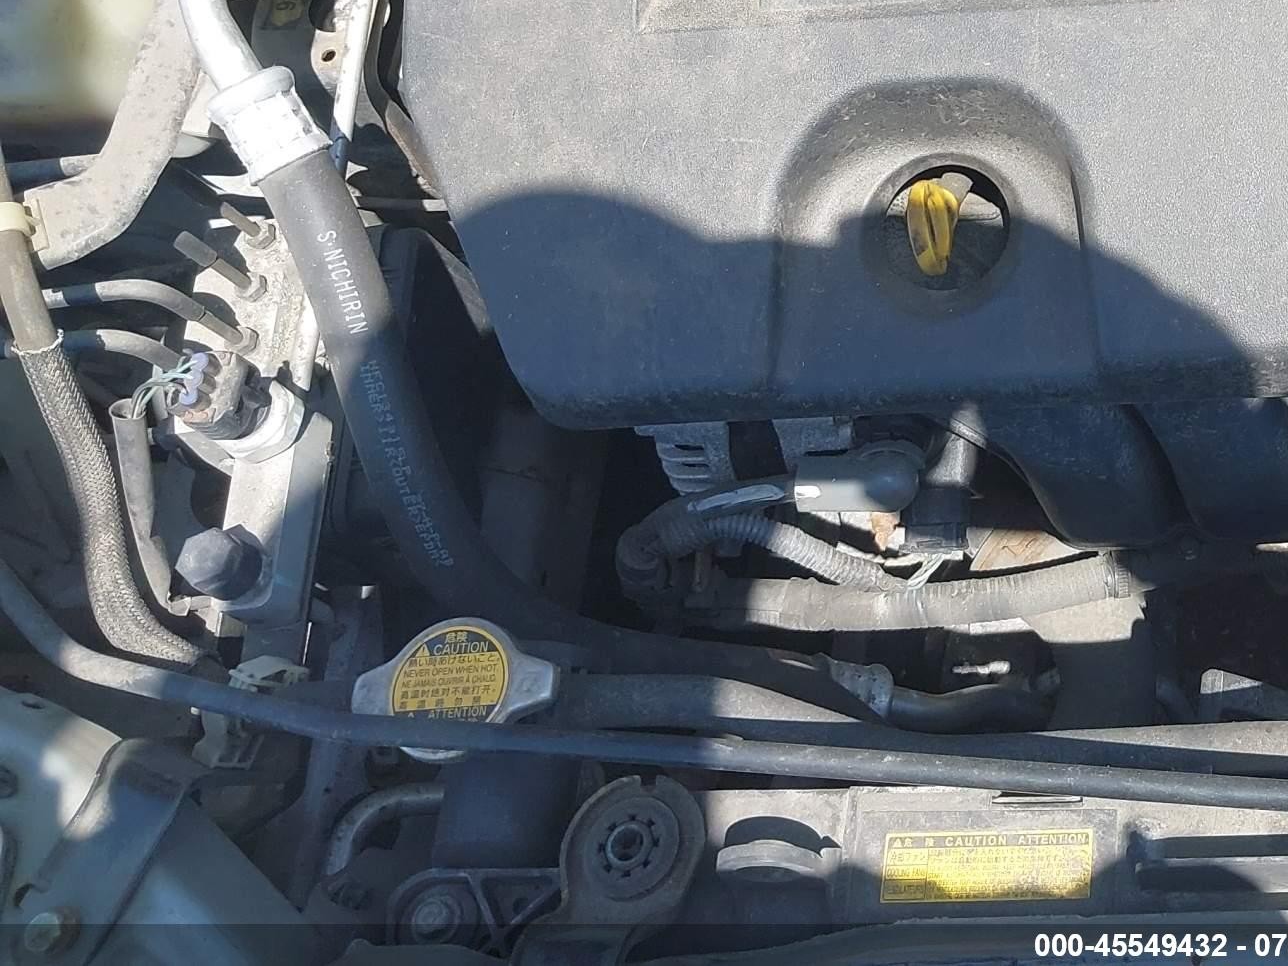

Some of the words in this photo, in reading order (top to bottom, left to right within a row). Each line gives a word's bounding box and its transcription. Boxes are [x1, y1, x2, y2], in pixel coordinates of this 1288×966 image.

[433, 641, 489, 656] CAUTION
[404, 669, 430, 678] NEVER
[431, 667, 454, 677] OPEN
[455, 665, 479, 674] WHEN
[428, 705, 487, 719] ATTENTION
[945, 836, 1007, 847] CAUTION
[1017, 834, 1087, 845] ATTENTION
